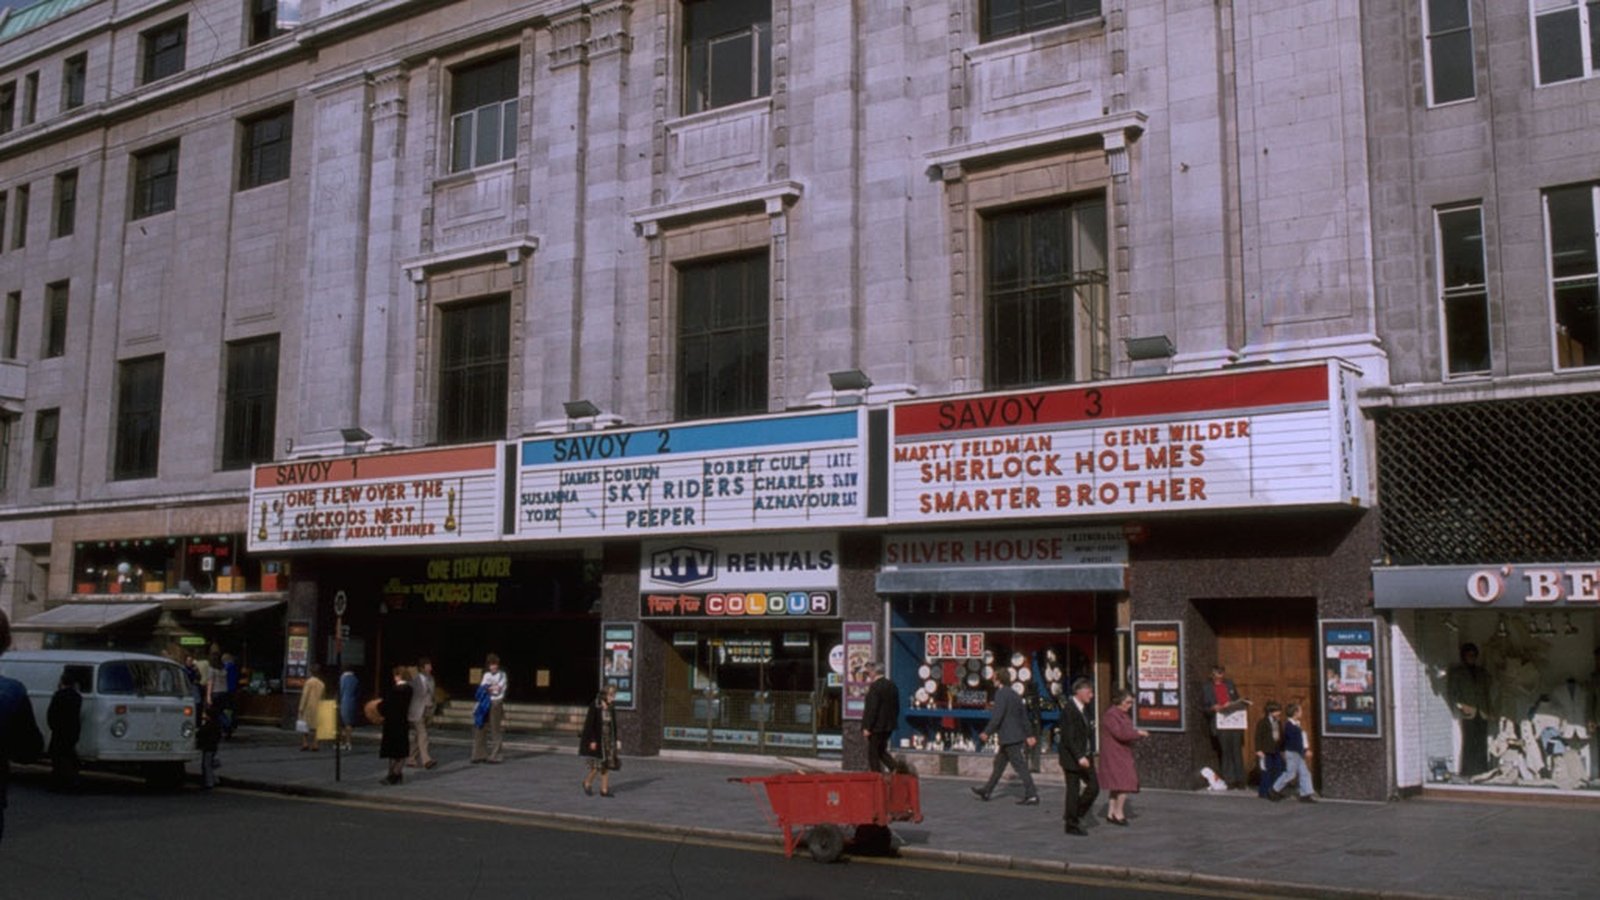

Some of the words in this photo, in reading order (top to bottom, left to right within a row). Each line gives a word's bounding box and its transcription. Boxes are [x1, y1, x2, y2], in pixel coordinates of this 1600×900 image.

[939, 395, 1045, 430] SAVOY
[1084, 390, 1103, 417] 3
[553, 433, 631, 462] SAVOY
[658, 429, 671, 453] 2
[895, 442, 953, 462] MARTY
[962, 435, 1052, 458] FELDMAN
[1104, 426, 1159, 447] GENE
[1170, 420, 1250, 443] WILDER
[276, 462, 333, 485] SAVOY
[351, 459, 358, 478] 1
[560, 470, 600, 485] JAMES
[603, 467, 660, 483] COBURN
[770, 455, 809, 471] CULP
[920, 452, 1061, 483] SHERLOCK
[1075, 445, 1206, 472] HOLMES
[287, 490, 315, 507] ONE
[322, 486, 363, 504] FLEW
[366, 484, 405, 501] OVER
[412, 481, 443, 498] THE
[607, 480, 650, 502] SKY
[663, 476, 745, 500] RIDERS
[754, 474, 824, 490] CHARLES
[520, 489, 579, 506] SUSANNA
[754, 492, 840, 510] AZNAVOUR
[919, 485, 1046, 514] SMARTER
[1055, 477, 1207, 507] BROTHER
[295, 509, 366, 528] CUCKOOS
[374, 506, 415, 524] NEST
[526, 507, 560, 522] YORK
[625, 507, 695, 529] PEEPER
[291, 528, 341, 541] ACADEMY
[346, 525, 385, 538] AWARD
[391, 523, 436, 537] WINNER
[653, 550, 713, 576] RTV
[727, 550, 834, 572] RENTALS
[887, 540, 966, 563] SILVER
[974, 538, 1063, 561] HOUSE
[427, 560, 450, 579] ONE
[707, 595, 828, 613] COLOUR
[927, 634, 983, 657] SALE
